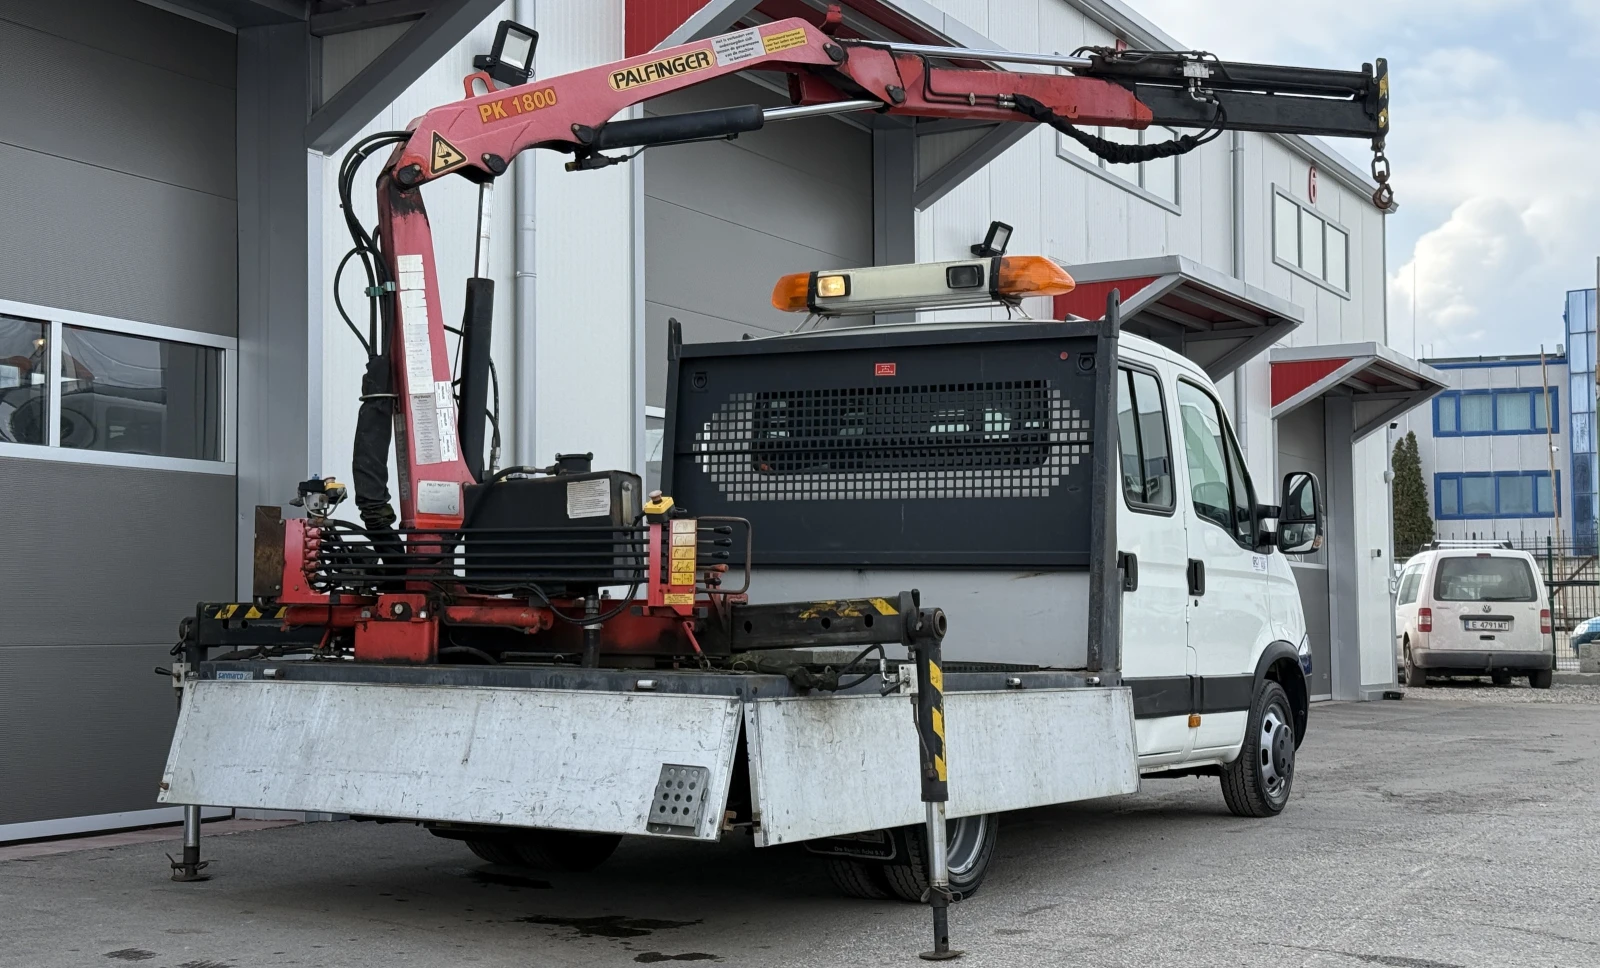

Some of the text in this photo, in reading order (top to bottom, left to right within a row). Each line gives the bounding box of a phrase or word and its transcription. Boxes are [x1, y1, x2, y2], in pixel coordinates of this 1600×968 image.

[613, 51, 710, 89] PALFINGER
[478, 88, 557, 123] PK 1800
[1308, 165, 1318, 204] 6
